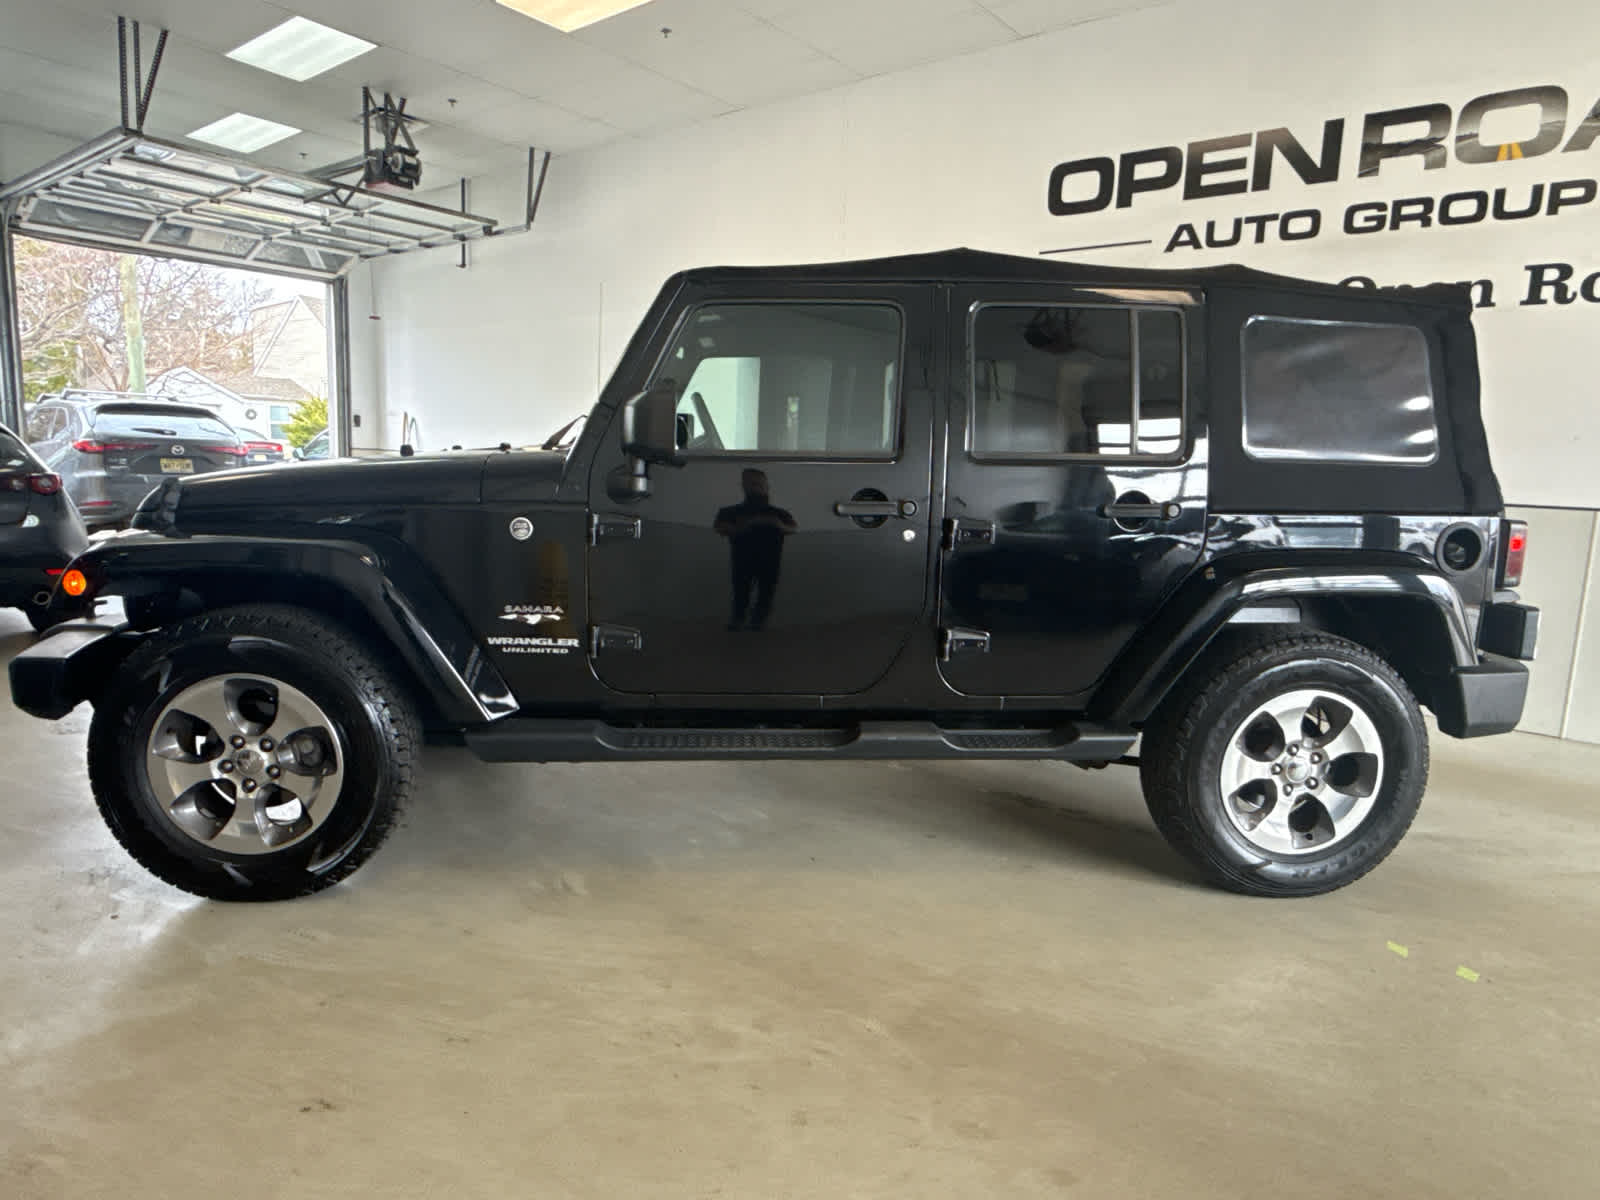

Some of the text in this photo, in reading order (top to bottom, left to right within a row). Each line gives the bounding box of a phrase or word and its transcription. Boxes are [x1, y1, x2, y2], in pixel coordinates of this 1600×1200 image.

[1047, 118, 1345, 216] OPEN
[1164, 179, 1598, 253] AUTO GROUP
[504, 605, 564, 613] SAHARA
[487, 637, 579, 648] WRANGLER
[502, 647, 569, 655] UNLIMITED
